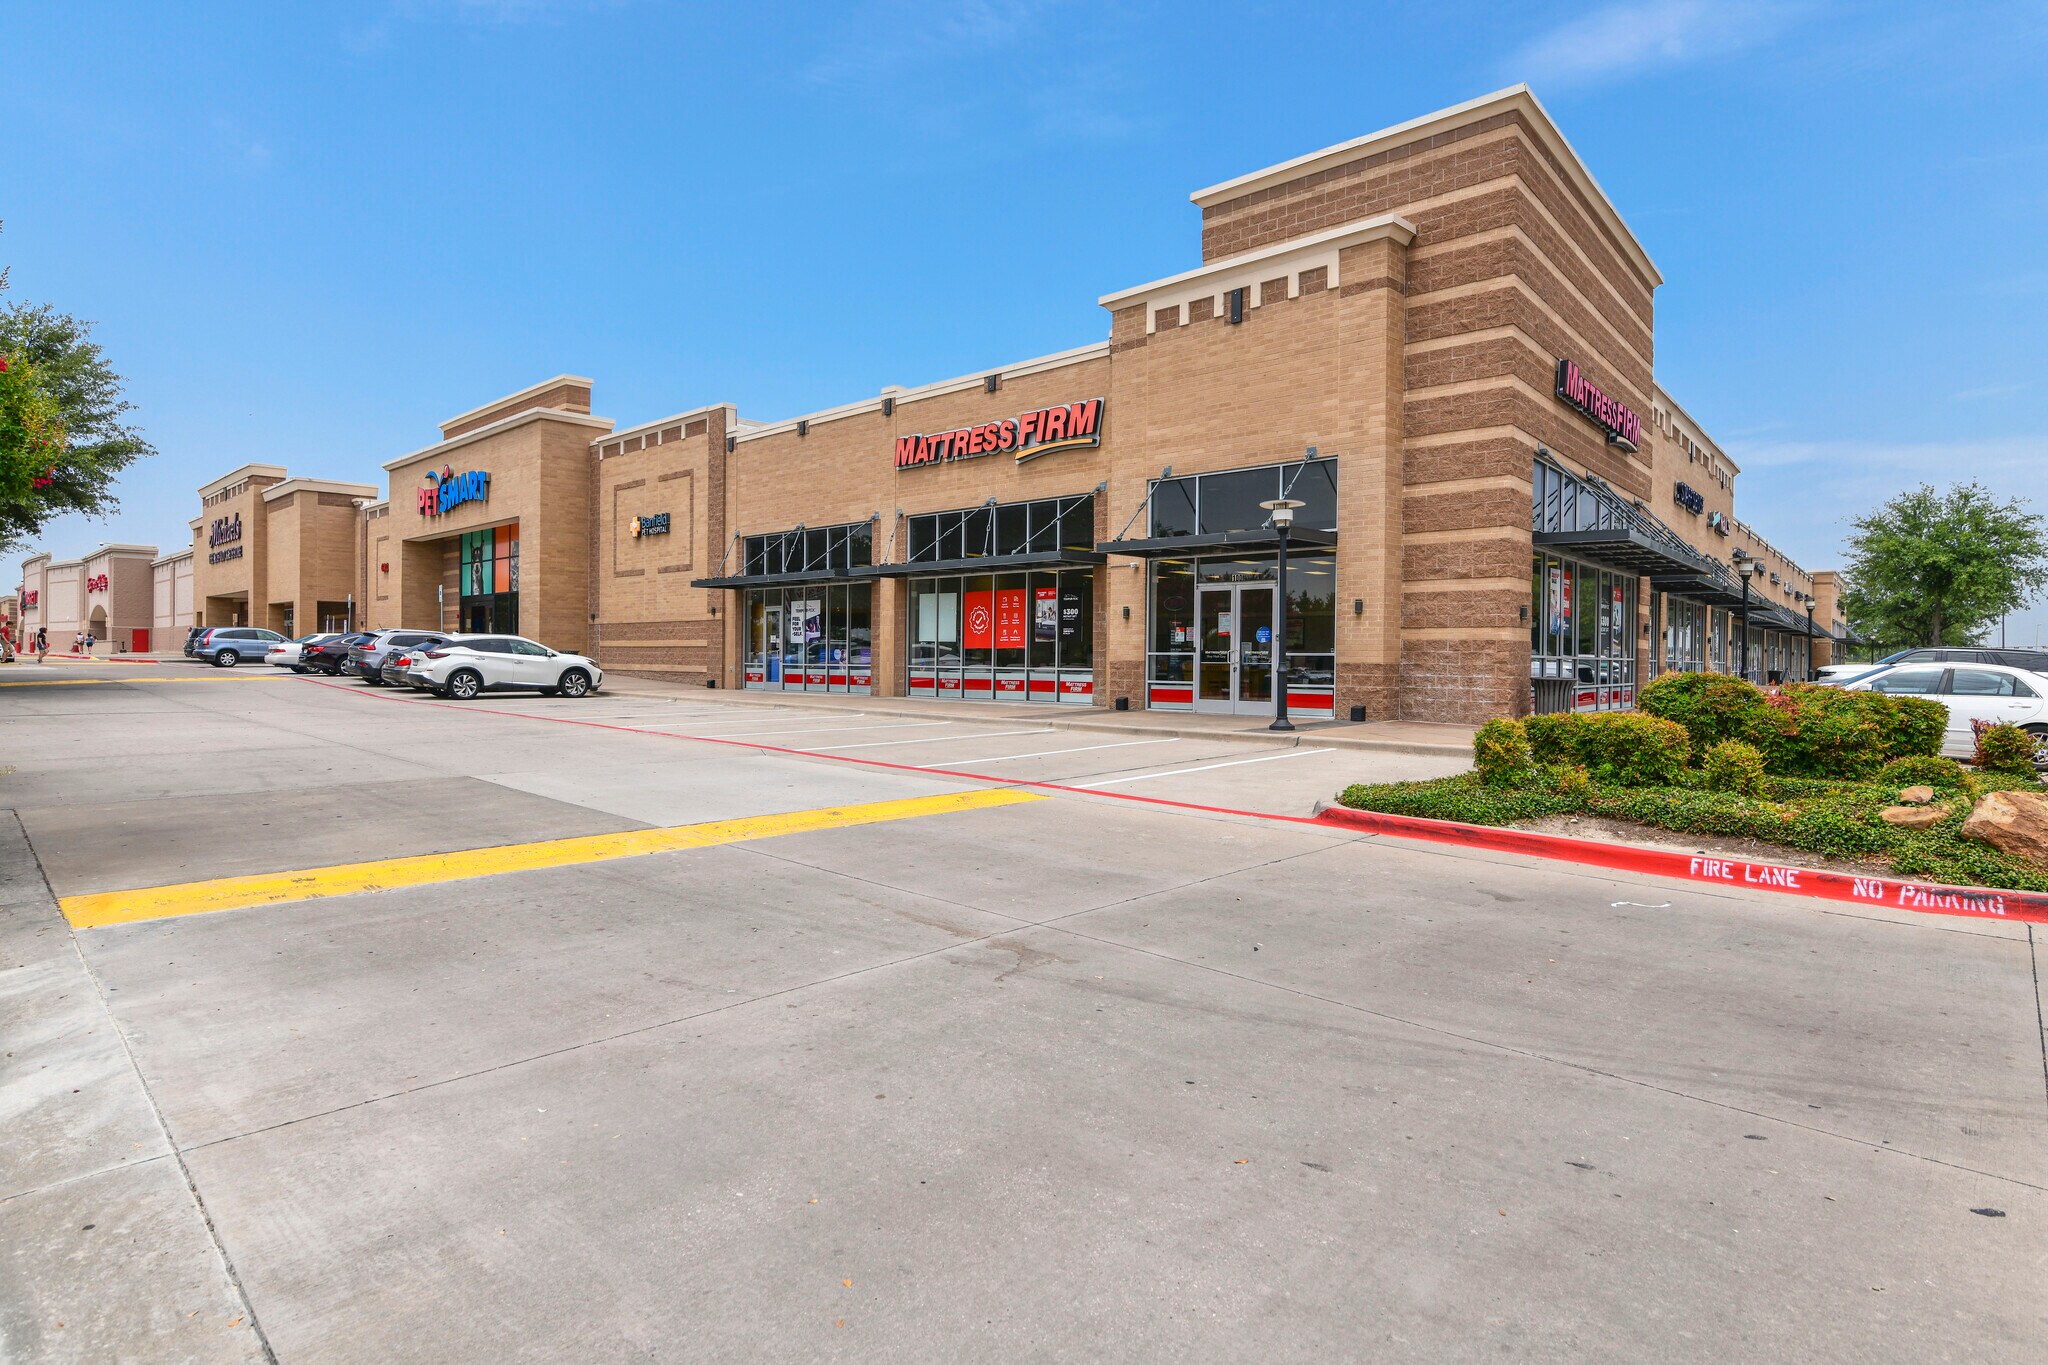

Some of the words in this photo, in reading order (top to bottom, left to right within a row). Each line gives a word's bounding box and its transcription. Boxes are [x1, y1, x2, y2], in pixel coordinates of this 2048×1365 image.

[641, 513, 668, 528] Banfield
[649, 526, 668, 535] HOSPITAL
[1690, 857, 1734, 879] FIRE
[1745, 864, 1801, 888] LANE
[1853, 878, 1883, 899] NO
